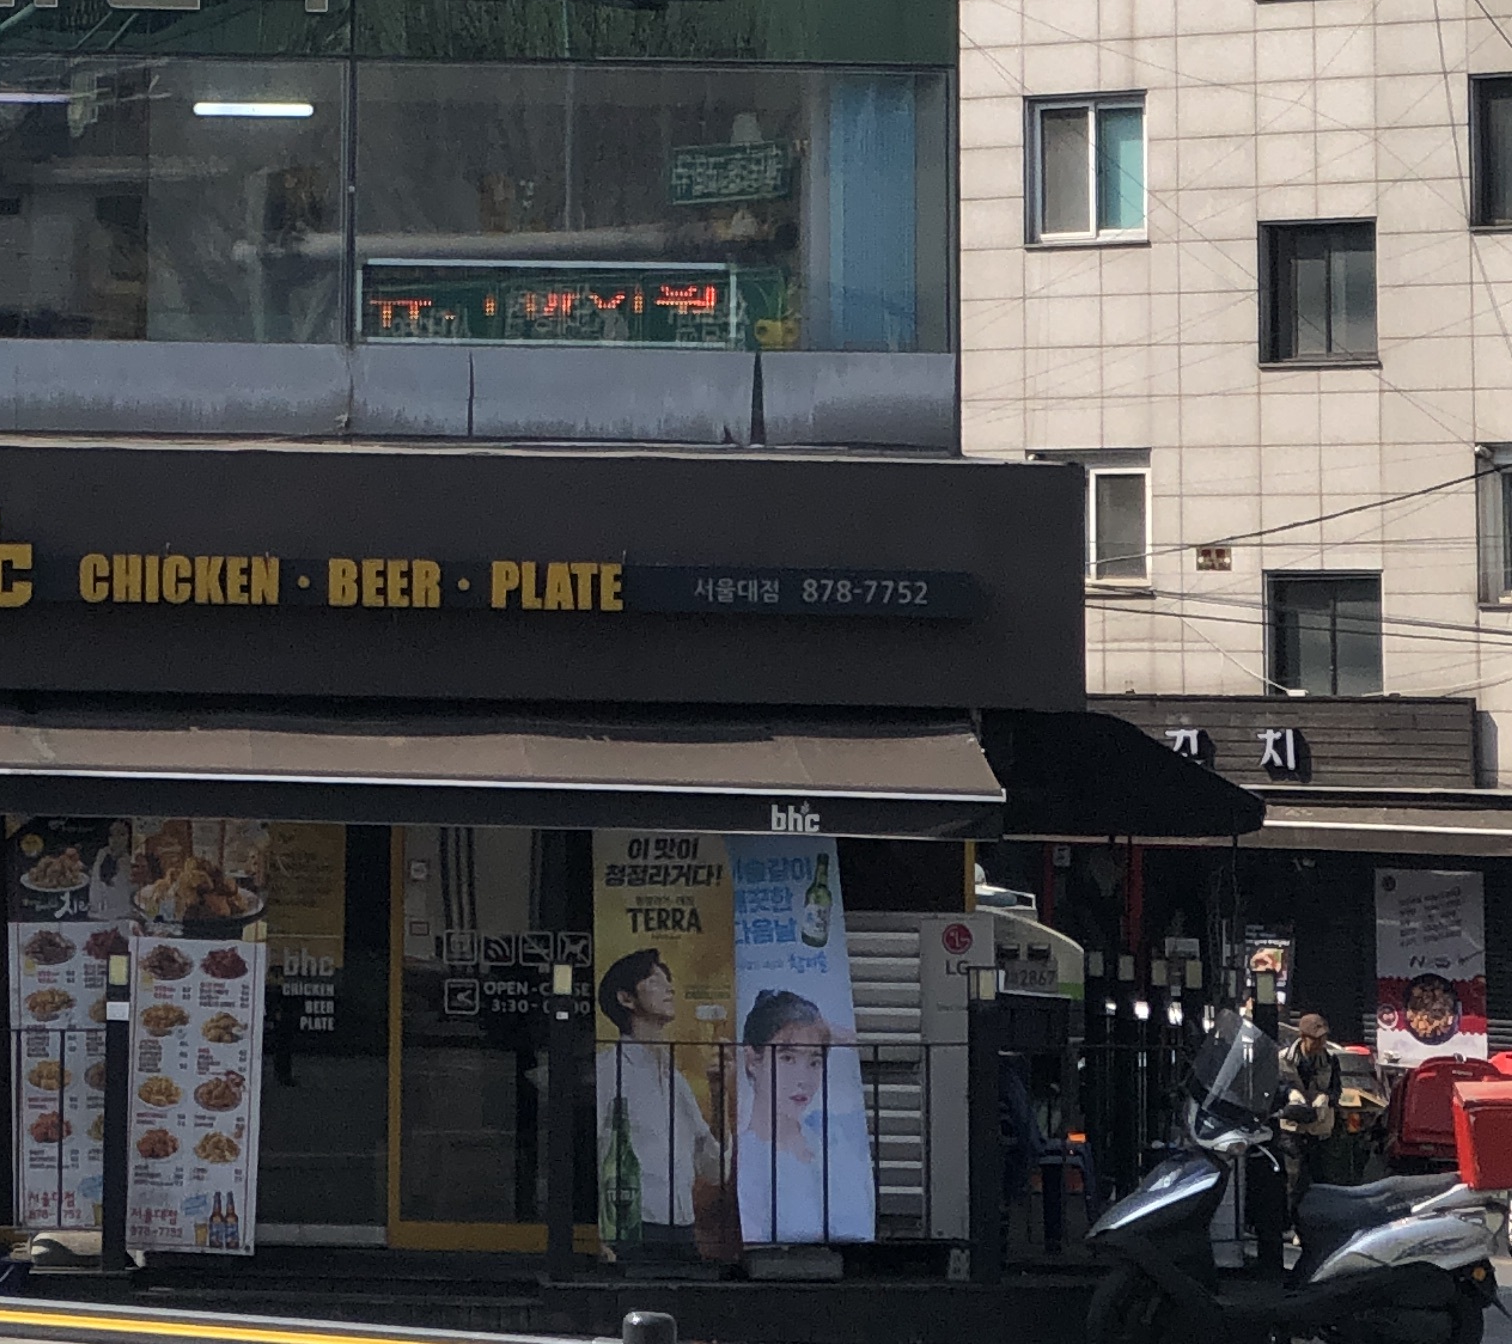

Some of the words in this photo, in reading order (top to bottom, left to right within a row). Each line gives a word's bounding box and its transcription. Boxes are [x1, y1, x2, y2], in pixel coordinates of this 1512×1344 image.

[78, 554, 281, 607] CHICKEN
[327, 557, 443, 610] BEER
[490, 559, 625, 613] PLATE
[693, 575, 781, 605] 서울대점
[801, 579, 930, 609] 878-7752
[770, 804, 820, 833] bhc
[627, 838, 650, 860] 이
[654, 837, 699, 861] 맛이
[626, 907, 704, 934] TERRA
[282, 948, 335, 977] bhc
[945, 960, 968, 976] LG
[281, 982, 335, 998] CHICKEN
[483, 980, 529, 996] OPEN
[299, 1015, 335, 1032] PLATE
